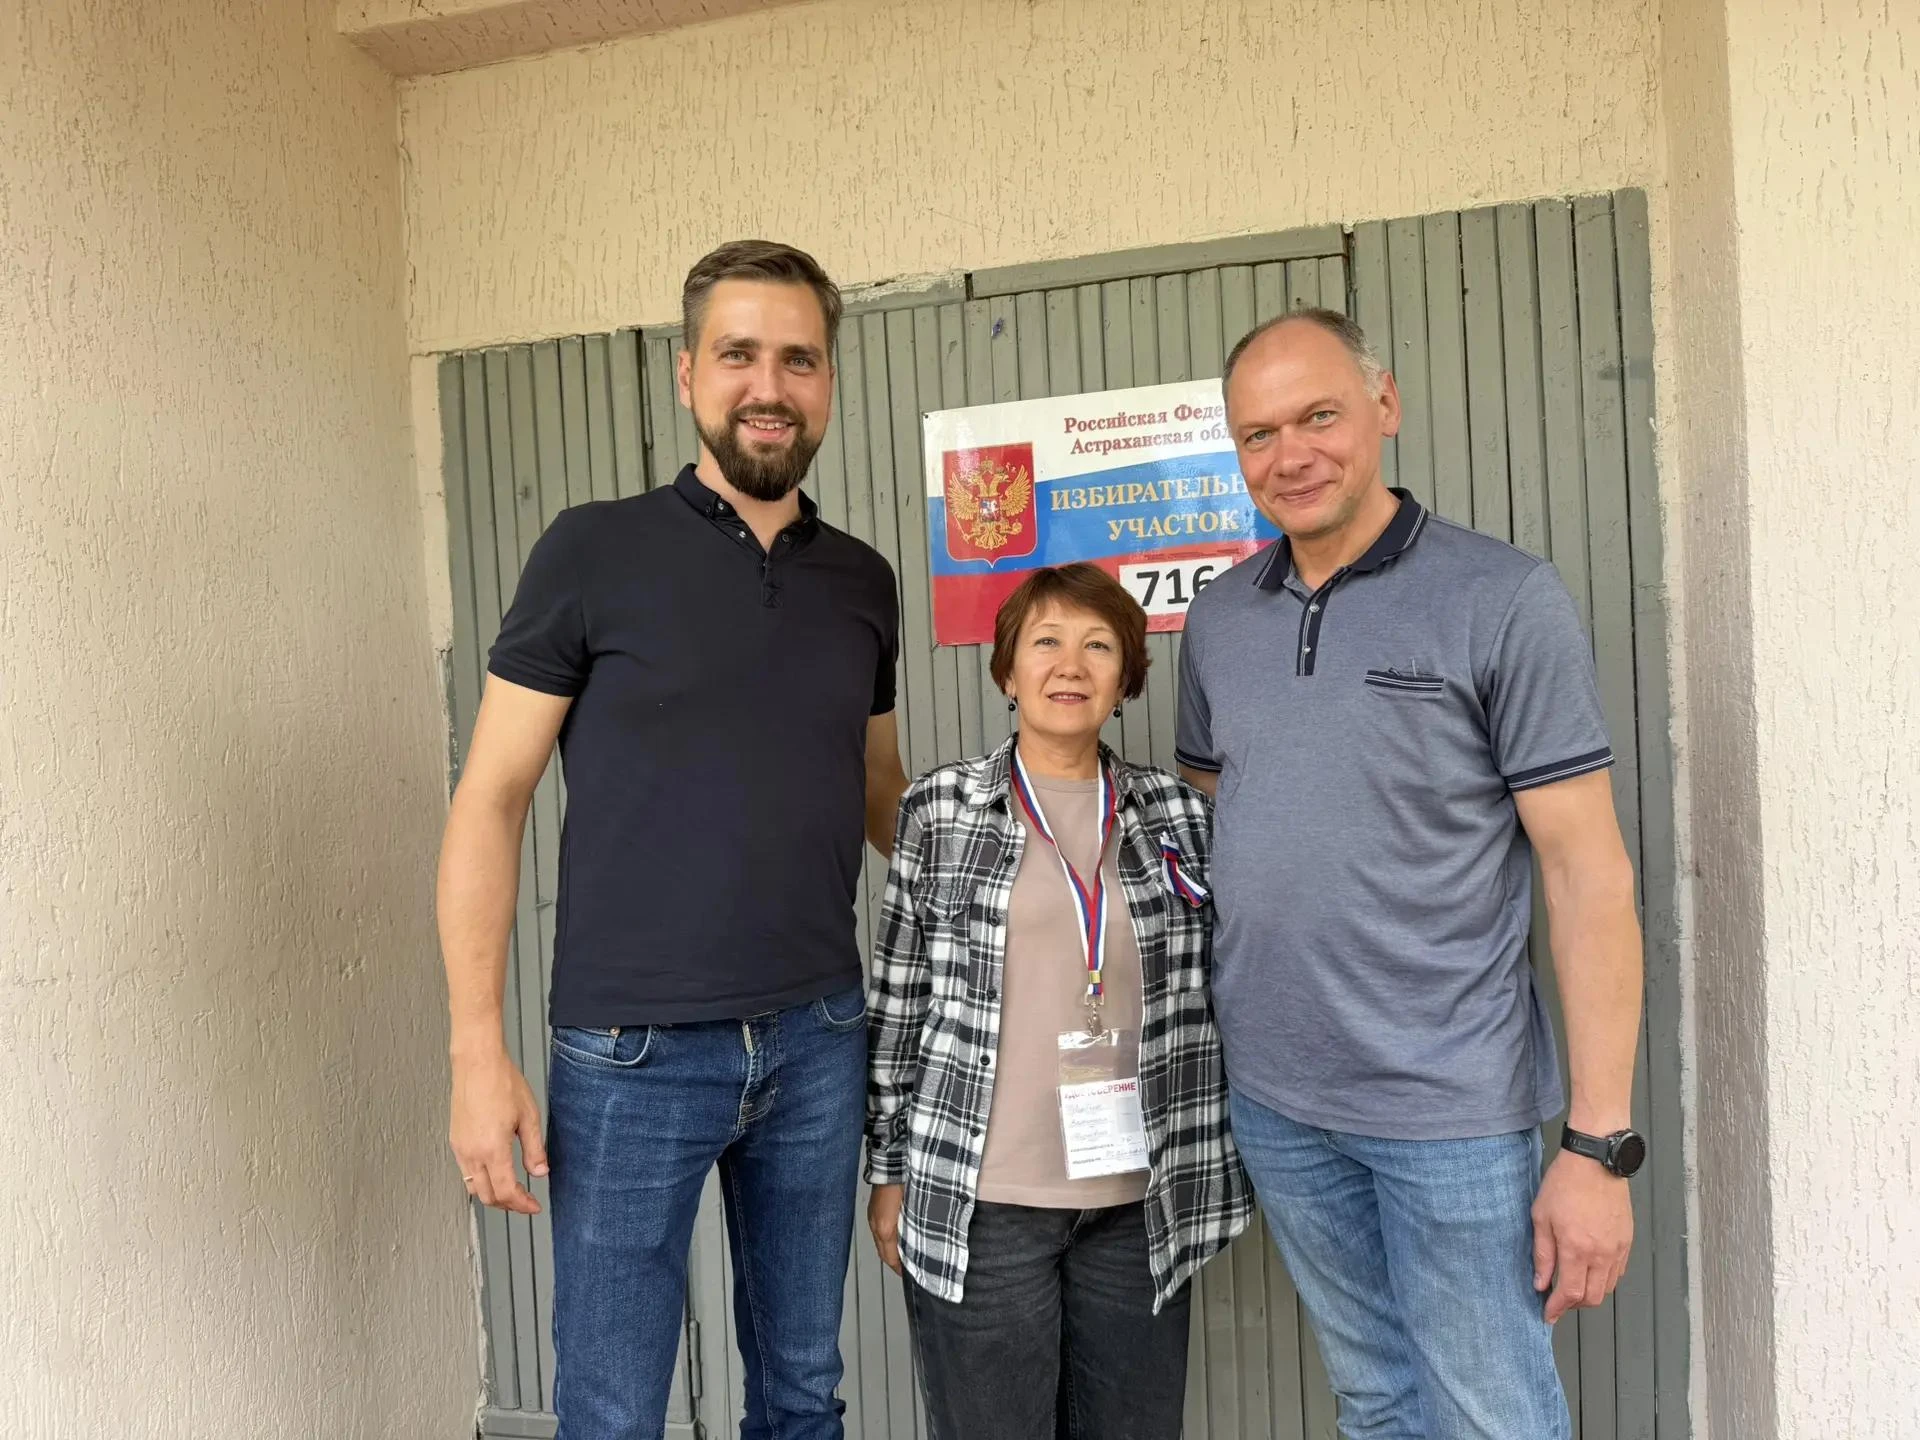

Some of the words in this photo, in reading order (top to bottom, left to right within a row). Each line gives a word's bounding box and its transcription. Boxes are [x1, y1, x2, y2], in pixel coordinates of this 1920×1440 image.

[1064, 411, 1168, 434] Российская
[1174, 404, 1225, 422] Феде
[1070, 430, 1194, 455] Астраханская
[1200, 423, 1233, 441] обл
[1051, 473, 1248, 512] ИЗБИРАТЕЛЬН
[1107, 508, 1240, 541] УЧАСТОК
[1136, 565, 1214, 607] 716
